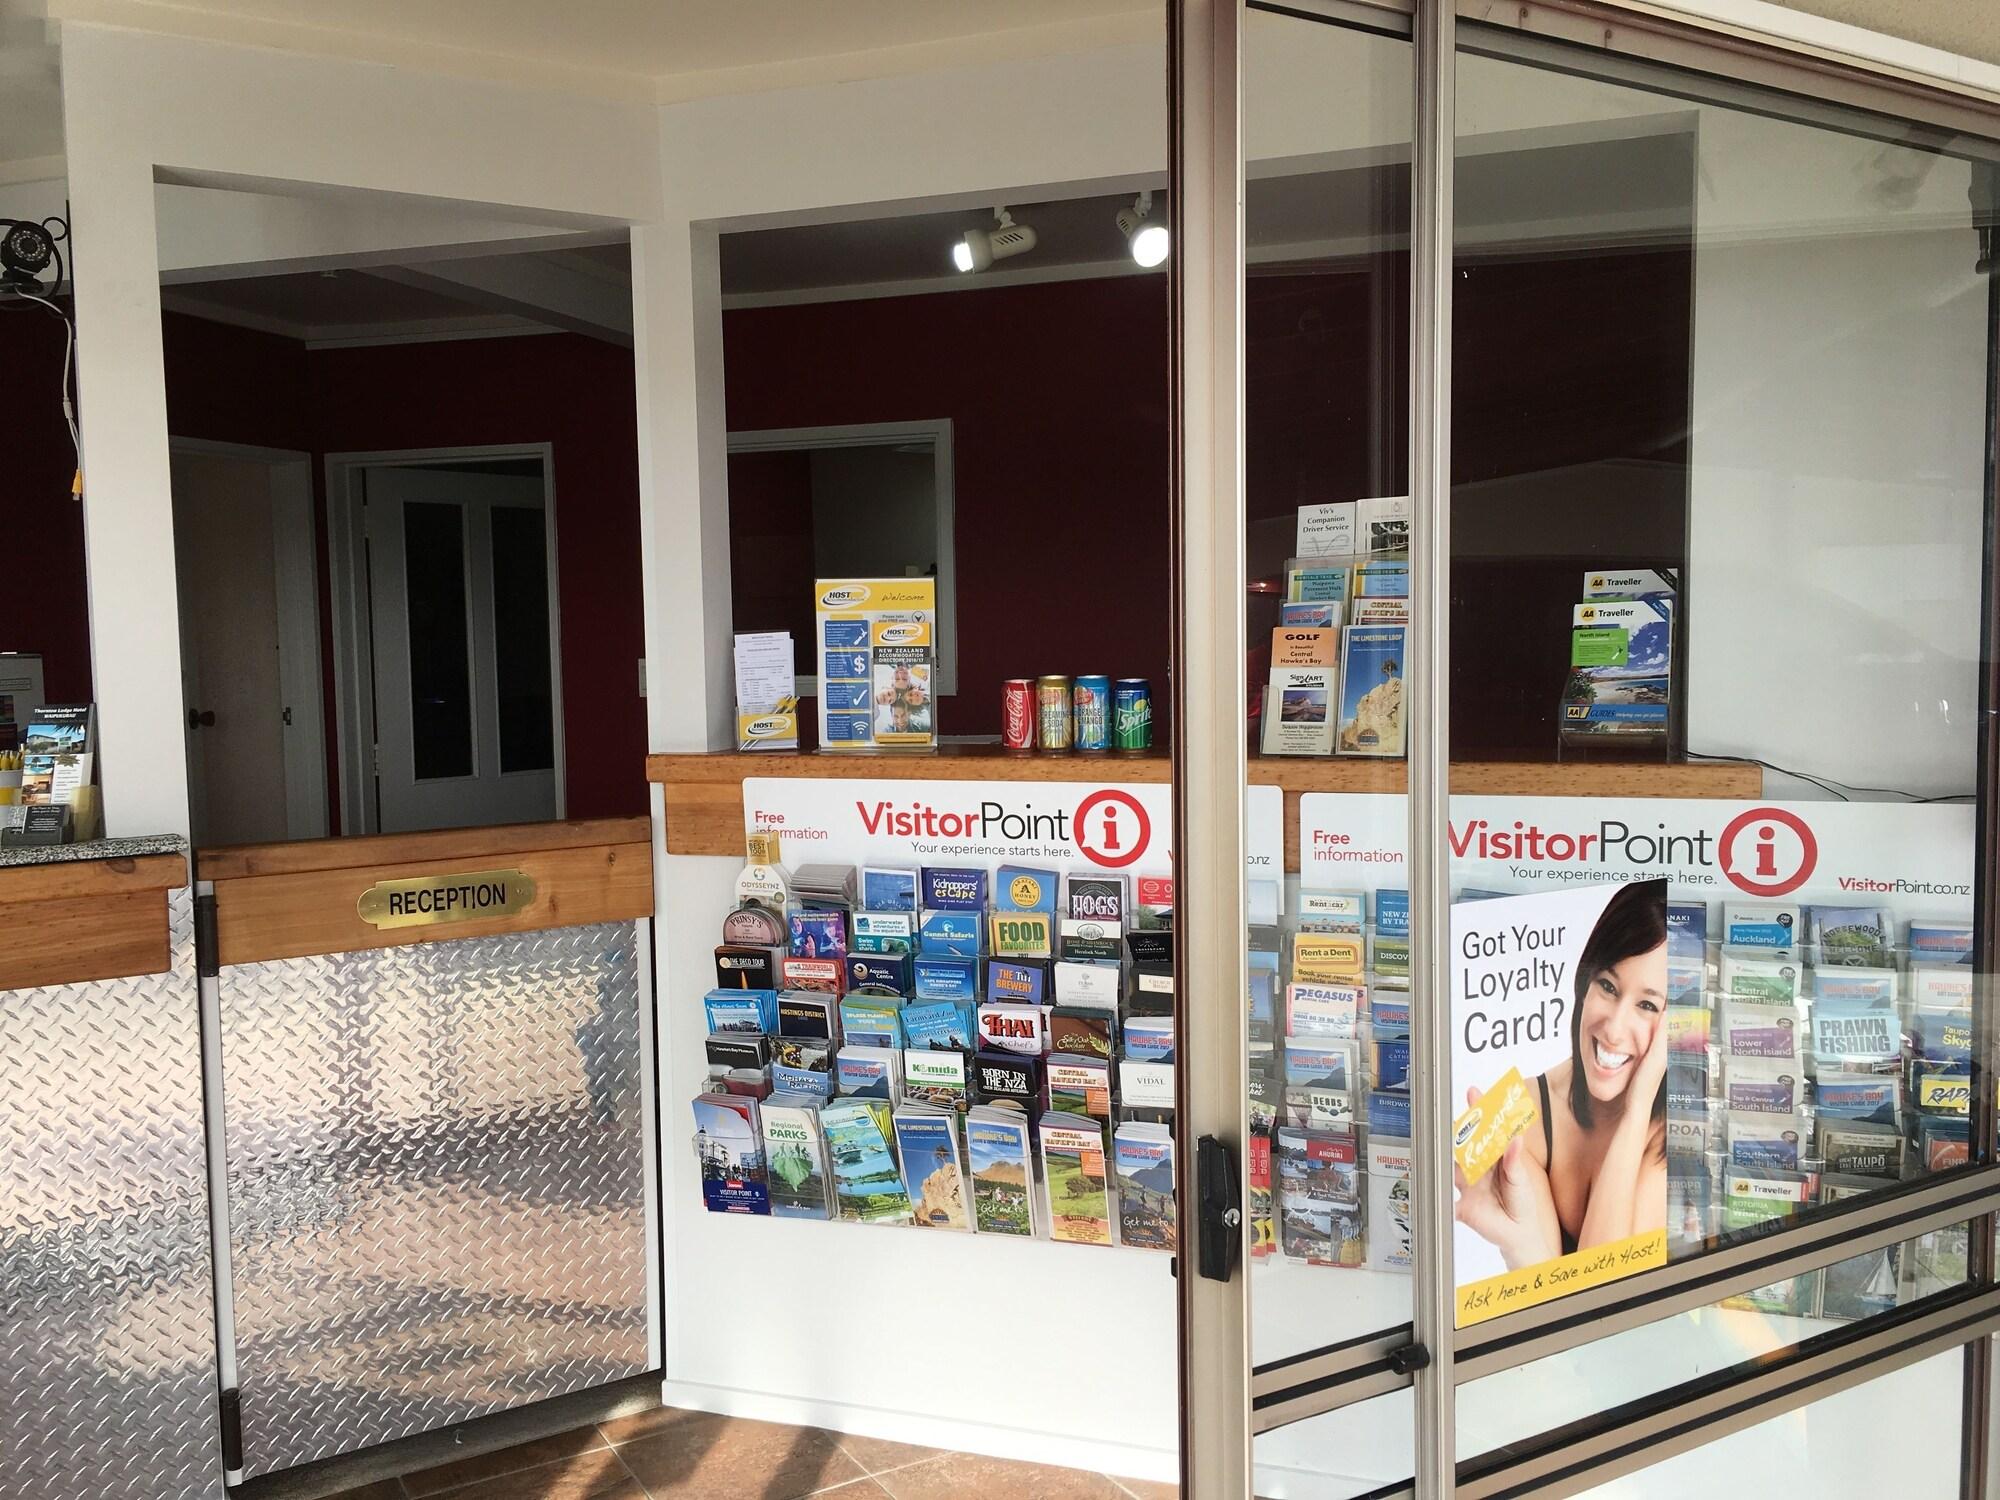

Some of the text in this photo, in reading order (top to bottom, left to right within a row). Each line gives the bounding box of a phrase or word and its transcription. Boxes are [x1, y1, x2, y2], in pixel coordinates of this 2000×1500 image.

[1319, 507, 1334, 515] Viv's
[1307, 515, 1346, 525] Companion
[1302, 523, 1350, 533] Driver Service
[1607, 578, 1642, 586] Traveller
[882, 592, 926, 602] Welcome
[1598, 609, 1634, 617] Traveller
[1285, 633, 1320, 642] GOLF
[1308, 658, 1322, 666] Bay
[1568, 708, 1616, 718] AA GUIDES
[753, 721, 774, 729] HOST
[755, 810, 785, 824] Free
[856, 801, 1070, 842] VisitorPoint
[1313, 830, 1350, 844] Free
[1449, 820, 1714, 866] VisitorPoint
[912, 842, 1074, 858] Your experience starts here.
[1314, 846, 1404, 863] information
[1509, 865, 1544, 880] Your
[1546, 868, 1629, 884] experience
[1678, 870, 1718, 886] here.
[1838, 876, 1972, 896] VisitorPoint.co.nz
[390, 882, 506, 916] RECEPTION
[1072, 895, 1118, 918] HOGS
[730, 914, 763, 928] PRINSY'S
[924, 930, 949, 938] Gannet
[998, 922, 1046, 942] FOOD
[1462, 924, 1566, 959] Got Your
[1732, 934, 1776, 944] Auckland
[1000, 940, 1045, 950] FAVOURITES
[999, 969, 1014, 979] THE
[1464, 957, 1565, 1002] Loyalty
[995, 980, 1033, 993] BREWERY
[1734, 985, 1769, 996] Central
[1294, 988, 1354, 1002] PEGASUS
[805, 1010, 826, 1018] DISTRICT
[982, 1014, 1035, 1038] THAI
[1464, 998, 1565, 1054] Card?
[1820, 1019, 1888, 1037] PRAWN
[1944, 1025, 1970, 1036] Taupo
[1733, 1039, 1763, 1047] Lower
[1820, 1036, 1891, 1053] FISHING
[1734, 1047, 1792, 1056] North Island
[778, 1072, 818, 1084] MOHAKA
[982, 1068, 1026, 1080] BORN IN
[1057, 1069, 1088, 1077] CENTRAL
[984, 1077, 1002, 1088] THE
[1004, 1078, 1027, 1090] NZA
[1379, 1099, 1410, 1107] BIRDWO
[1732, 1102, 1790, 1113] South Island
[770, 1121, 804, 1130] Regional
[1458, 1122, 1473, 1138] HOST
[1464, 1083, 1523, 1169] Rewards
[1669, 1124, 1702, 1137] ROA
[770, 1128, 808, 1140] PARKS
[1148, 1147, 1164, 1157] BAY
[1319, 1151, 1344, 1159] AHURIRI
[1736, 1150, 1780, 1159] Southern
[1765, 1160, 1795, 1169] Island
[1753, 1186, 1792, 1195] Traveller
[980, 1203, 998, 1216] Get
[1014, 1204, 1024, 1213] to
[1123, 1216, 1140, 1227] Get
[1158, 1216, 1169, 1227] to
[1464, 1238, 1661, 1311] Ask here & Save with Host!
